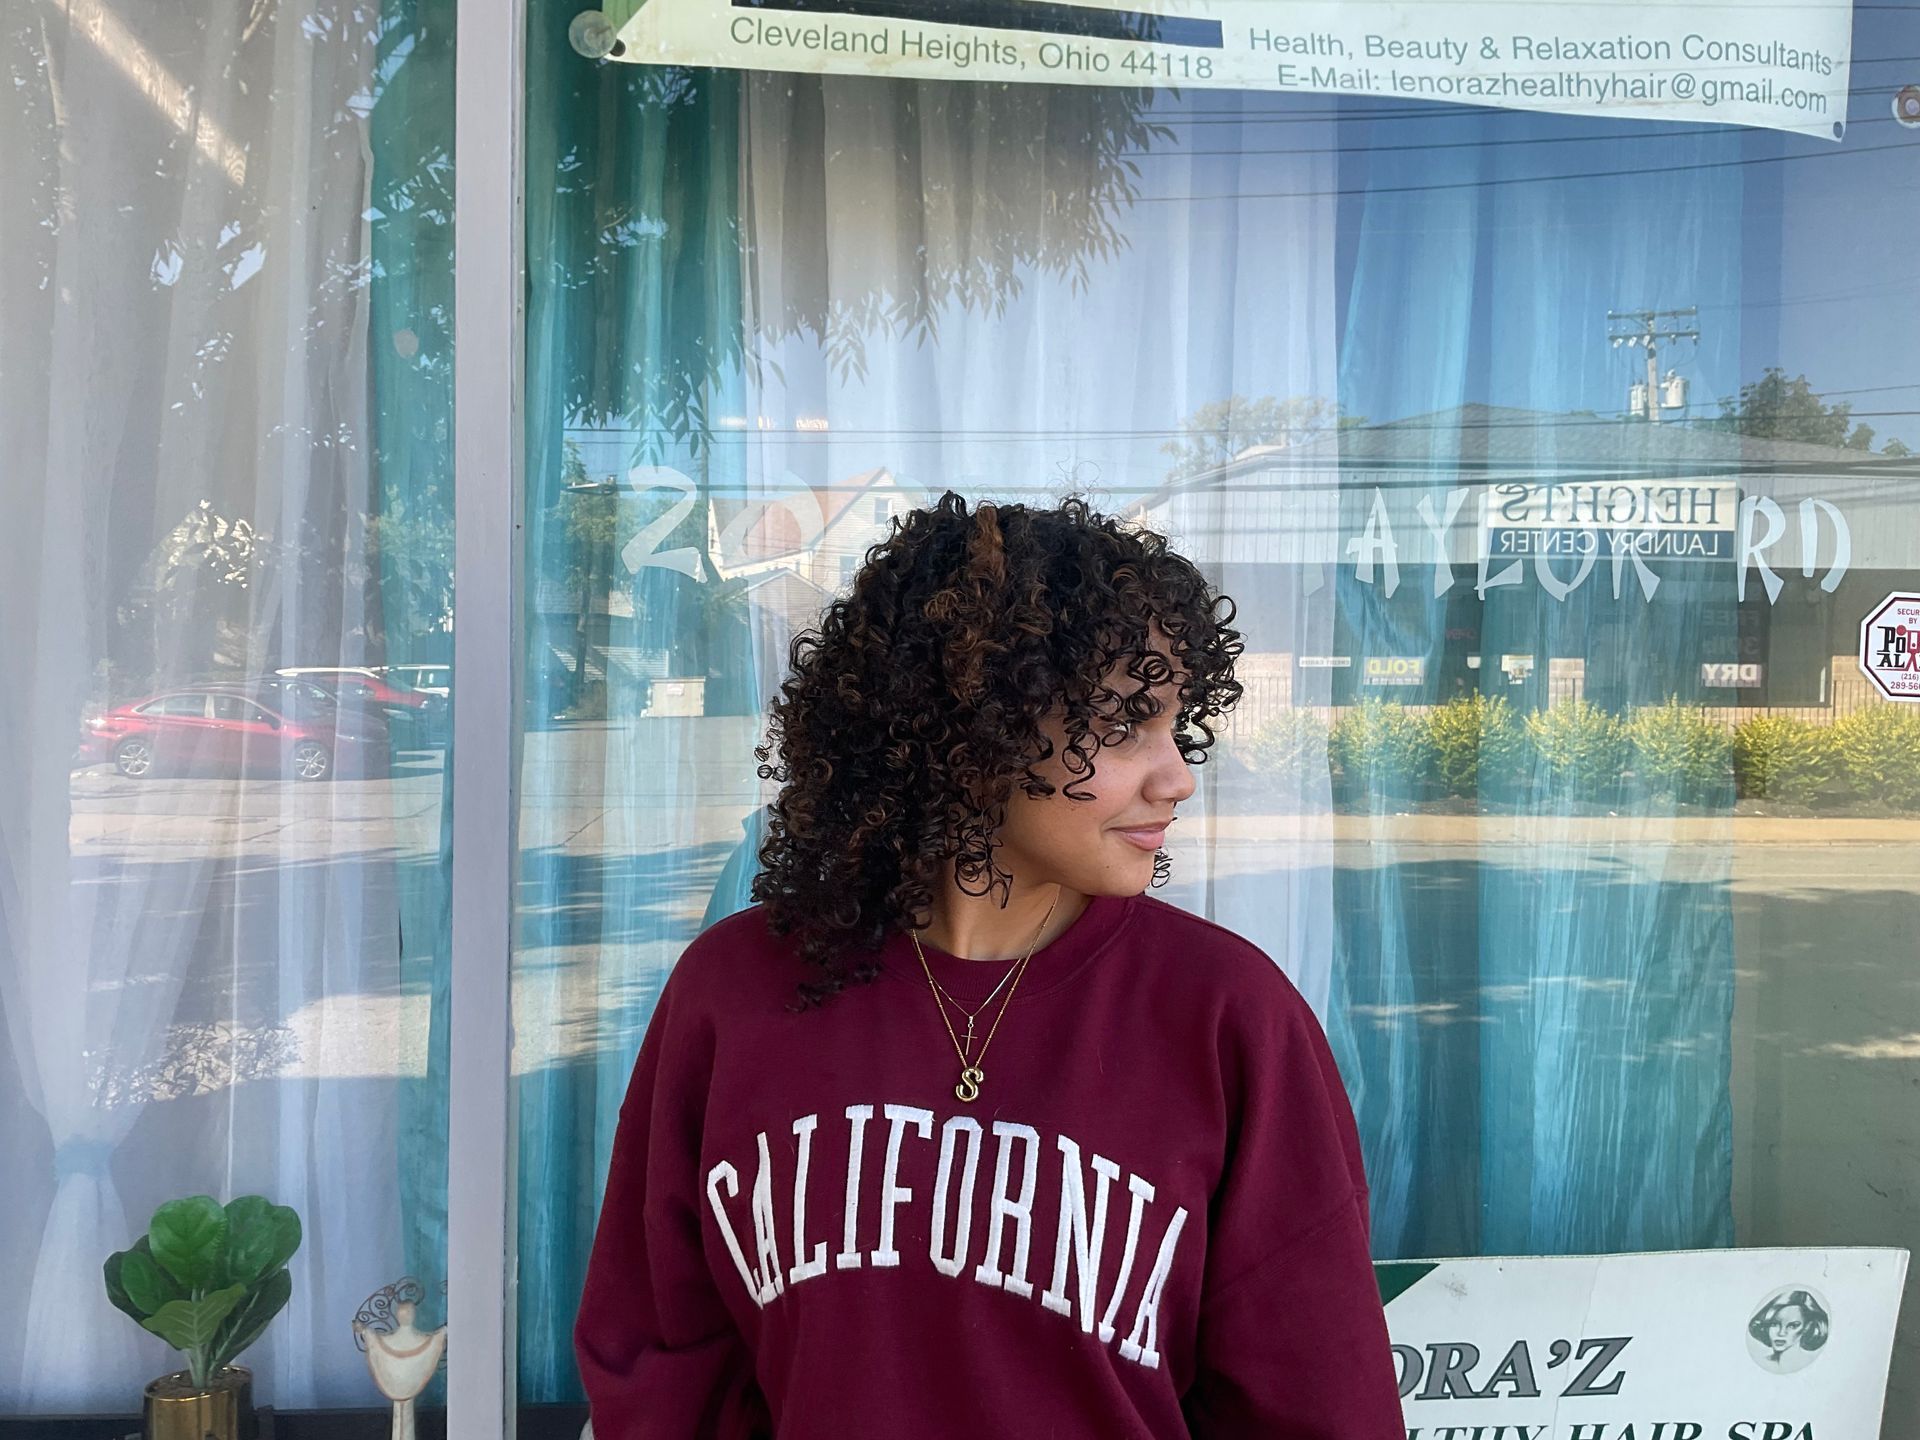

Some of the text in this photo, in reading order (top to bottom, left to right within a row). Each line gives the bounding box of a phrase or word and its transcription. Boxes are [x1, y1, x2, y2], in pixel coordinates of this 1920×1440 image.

[730, 16, 1214, 79] Cleveland Heights, Ohio 44118
[1249, 27, 1833, 76] Health, Beauty & Relaxation Consultants
[1277, 63, 1828, 114] E-Mail: lenorazhealthyhair@gmail.com
[1737, 496, 1852, 606] RD
[1908, 617, 1918, 625] BY
[1890, 681, 1920, 690] 289-56
[1901, 673, 1919, 681] (216)
[707, 1103, 1188, 1369] CALIFORNIA
